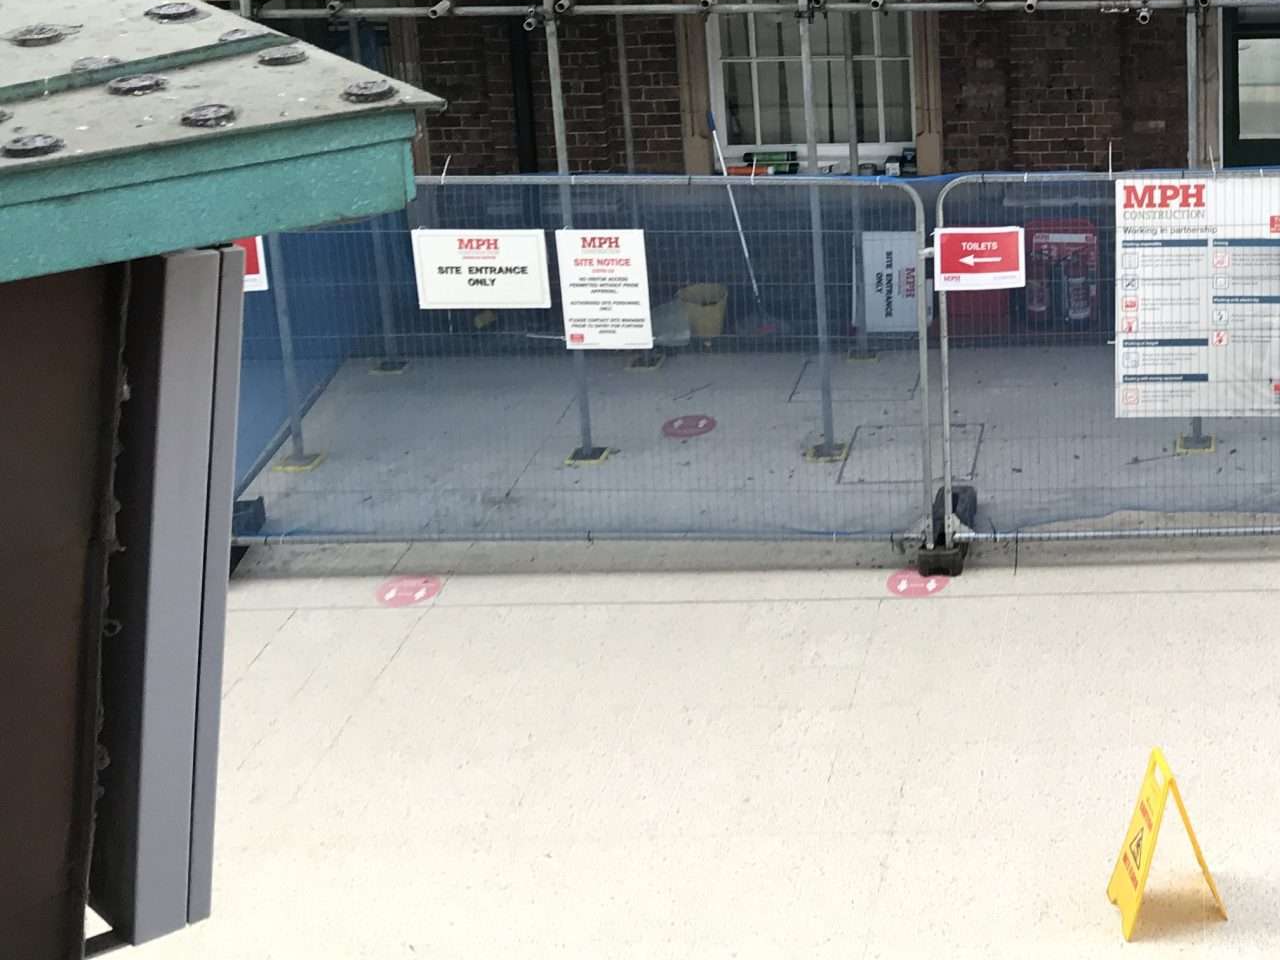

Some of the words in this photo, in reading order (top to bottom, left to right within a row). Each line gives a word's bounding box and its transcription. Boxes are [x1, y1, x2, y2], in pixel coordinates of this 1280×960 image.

[1123, 184, 1206, 208] MPH
[1123, 209, 1206, 221] CONSTRUCTION
[1123, 227, 1158, 236] Working
[1170, 226, 1218, 235] partnership
[457, 238, 499, 250] MPH
[580, 236, 621, 249] MPH
[961, 241, 998, 251] TOILETS
[574, 258, 594, 267] SITE
[597, 258, 631, 267] NOTICE
[885, 251, 893, 269] SITE
[437, 266, 462, 275] SITE
[468, 266, 528, 275] ENTRANCE
[467, 278, 497, 287] ONLY
[875, 272, 883, 294] ONLY
[905, 268, 915, 298] MPH
[885, 273, 893, 318] ENTRANCE
